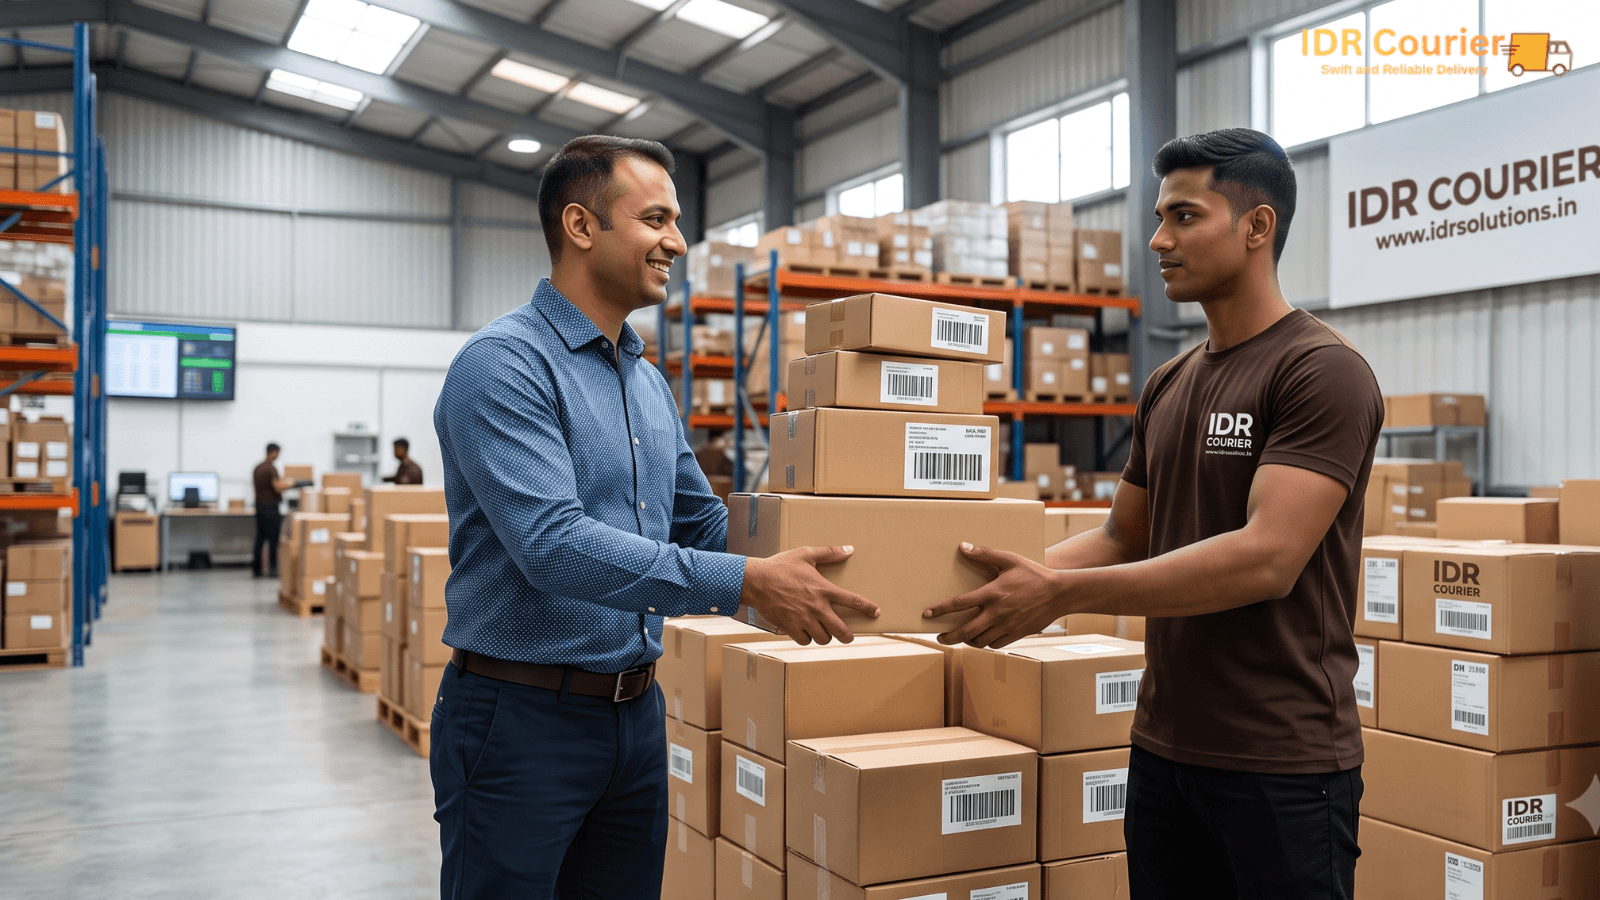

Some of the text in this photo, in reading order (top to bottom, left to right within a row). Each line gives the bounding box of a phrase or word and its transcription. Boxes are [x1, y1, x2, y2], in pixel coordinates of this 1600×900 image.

[1348, 145, 1600, 229] IDR COURIER
[1376, 197, 1577, 250] www.idrsolutions.in
[1208, 413, 1253, 436] IDR
[1206, 437, 1252, 448] COURIER
[1433, 560, 1480, 585] IDR
[1433, 584, 1481, 597] COURIER
[1507, 798, 1543, 817] IDR
[1507, 814, 1543, 826] COURIER
